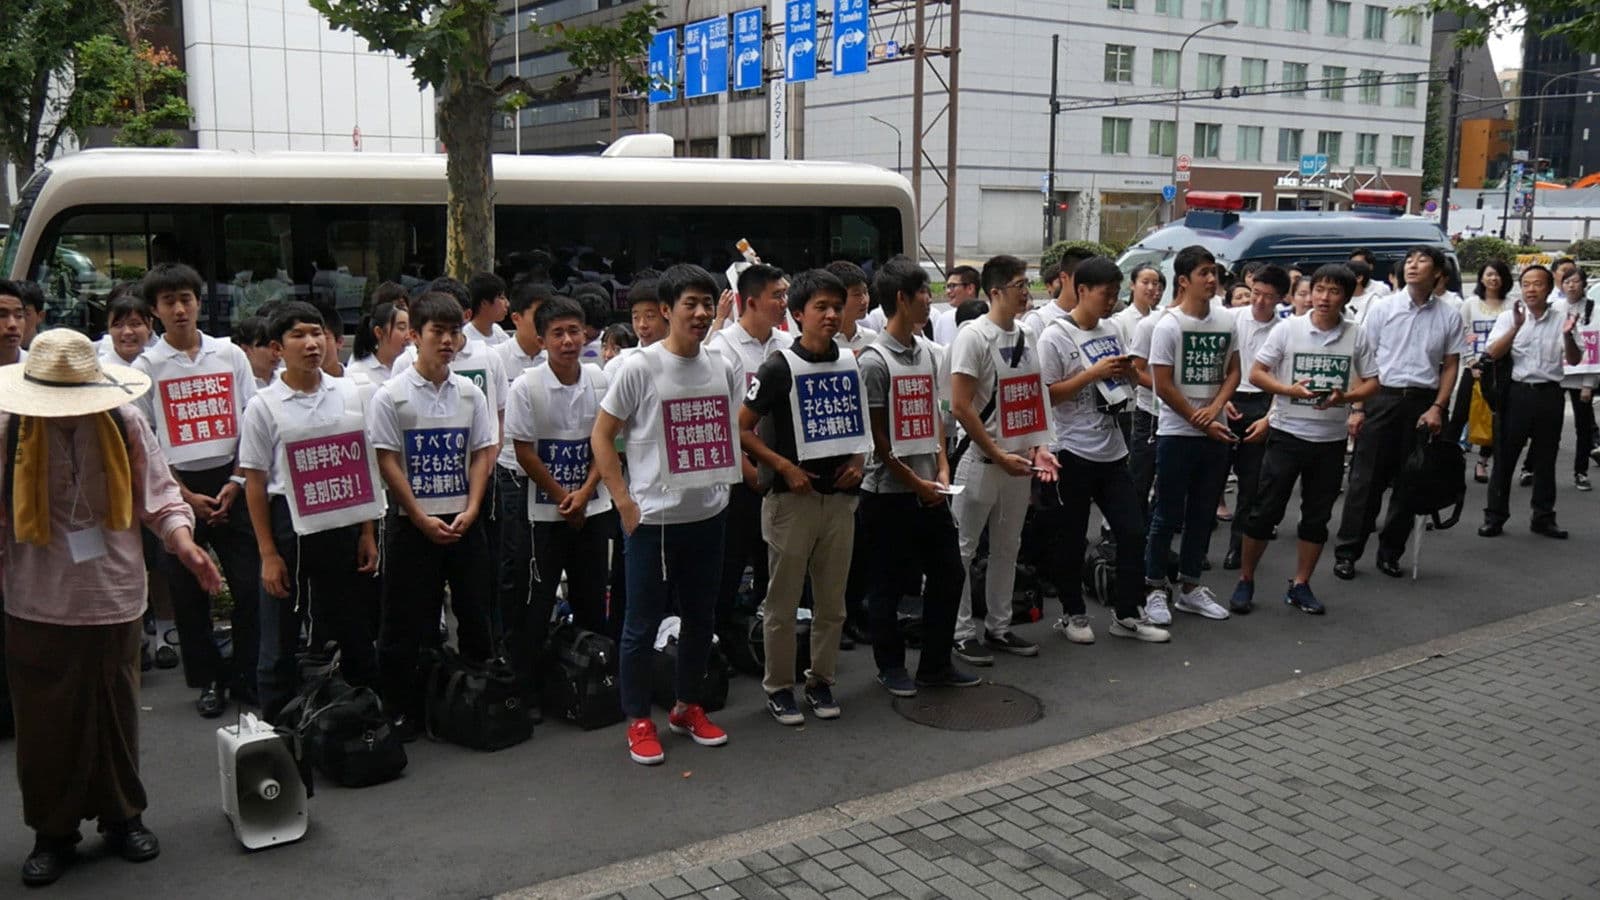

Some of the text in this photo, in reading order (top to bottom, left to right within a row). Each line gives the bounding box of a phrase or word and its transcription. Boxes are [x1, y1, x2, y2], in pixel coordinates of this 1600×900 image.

[1190, 335, 1226, 349] すべての
[167, 376, 228, 401] 朝鮮学校に
[805, 376, 852, 396] すべての
[670, 399, 724, 423] 朝鮮学校に
[804, 395, 858, 417] 子どもたちに
[414, 433, 465, 452] すべての
[294, 441, 361, 472] 朝鮮学校への
